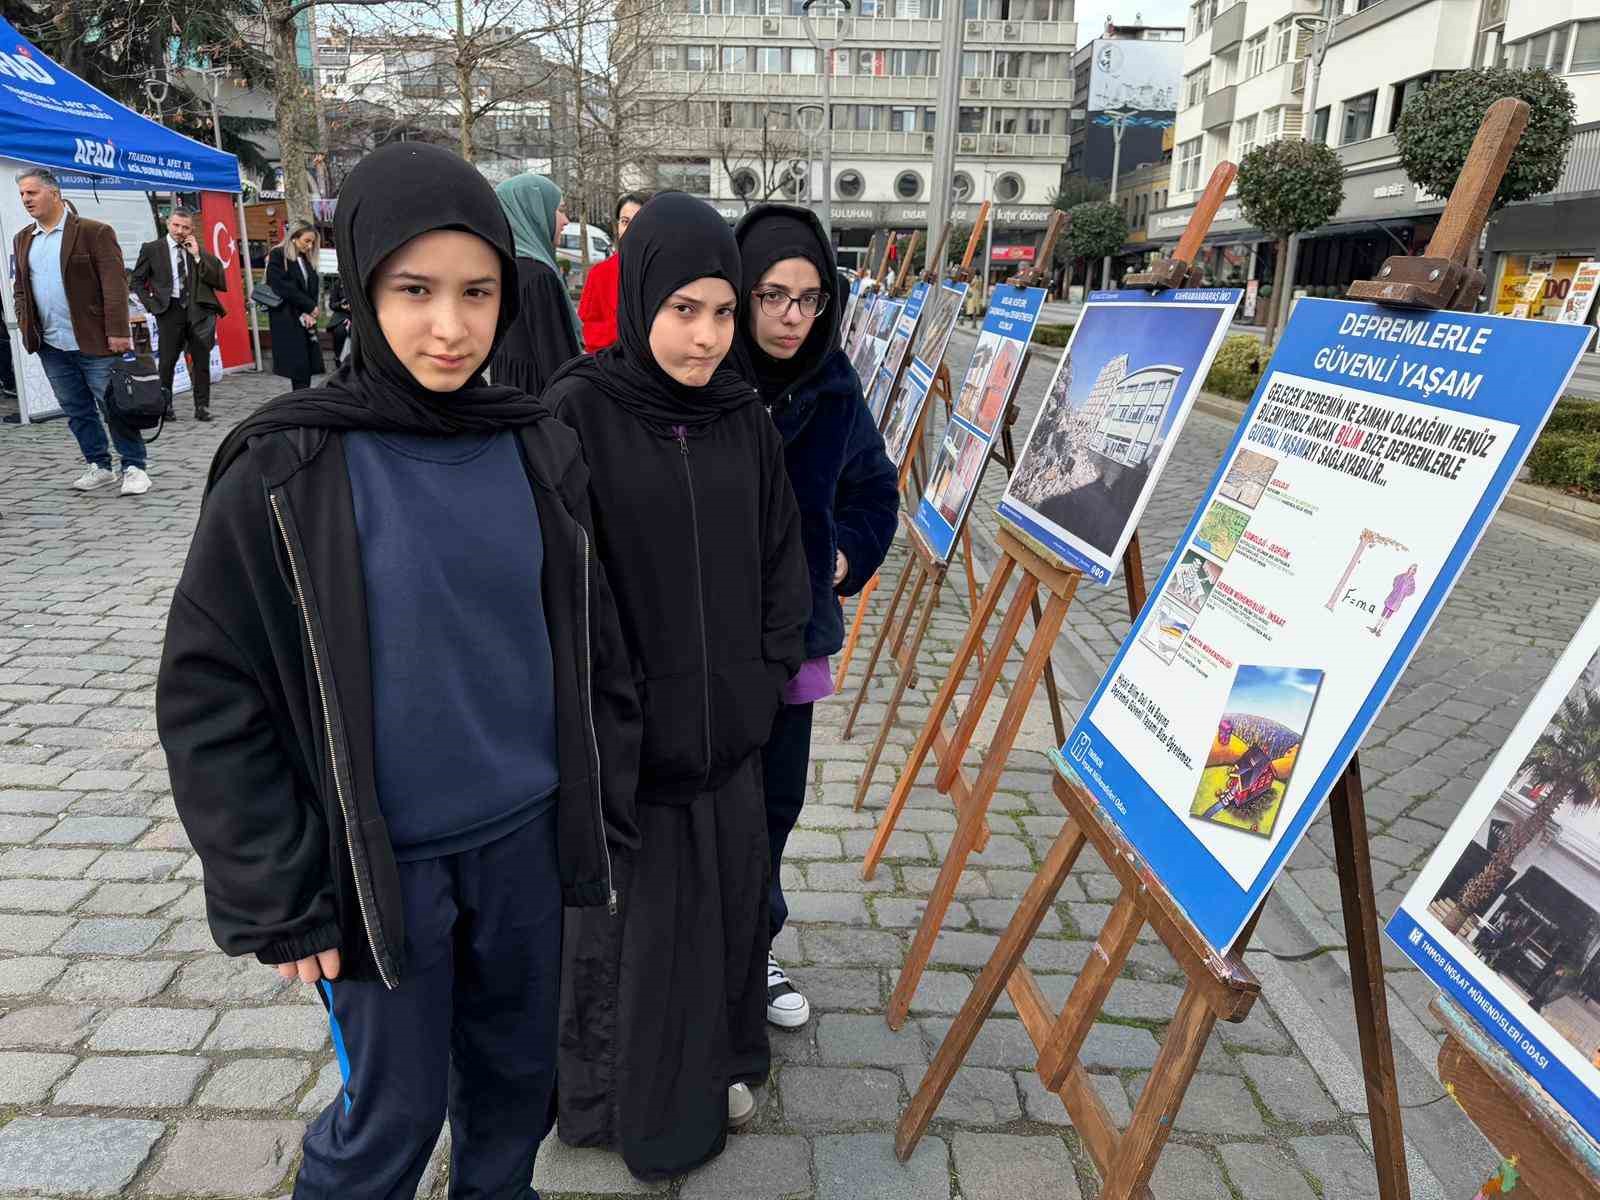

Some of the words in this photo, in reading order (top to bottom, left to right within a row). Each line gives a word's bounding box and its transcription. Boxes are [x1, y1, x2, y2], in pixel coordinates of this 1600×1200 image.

[74, 138, 115, 169] AFAD
[166, 161, 181, 169] AFET
[830, 207, 872, 219] SULUHAN
[1339, 312, 1492, 354] DEPREMLERLE
[1314, 344, 1400, 383] GÜVENLİ
[1397, 361, 1484, 400] YAŞAM
[1256, 402, 1310, 433] BİLEMİYORUZ
[1304, 416, 1340, 442] ANCAK
[1334, 422, 1366, 449] BİLİM
[1383, 439, 1467, 480] DEPREMLERLE
[1267, 382, 1305, 407] GELECEK
[1300, 391, 1346, 419] DEPREMİN
[1341, 400, 1360, 422] NE
[1354, 404, 1394, 431] ZAMAN
[1389, 412, 1453, 447] OLACAĞINI
[1447, 424, 1497, 458] HENÜZ
[1247, 421, 1279, 449] GÜVENLİ
[1279, 430, 1321, 462] YAŞAMAYI
[1420, 939, 1445, 967] TMMOB
[1467, 986, 1523, 1044] MÜHENDİSLERİ
[1519, 1041, 1549, 1070] ODASI
